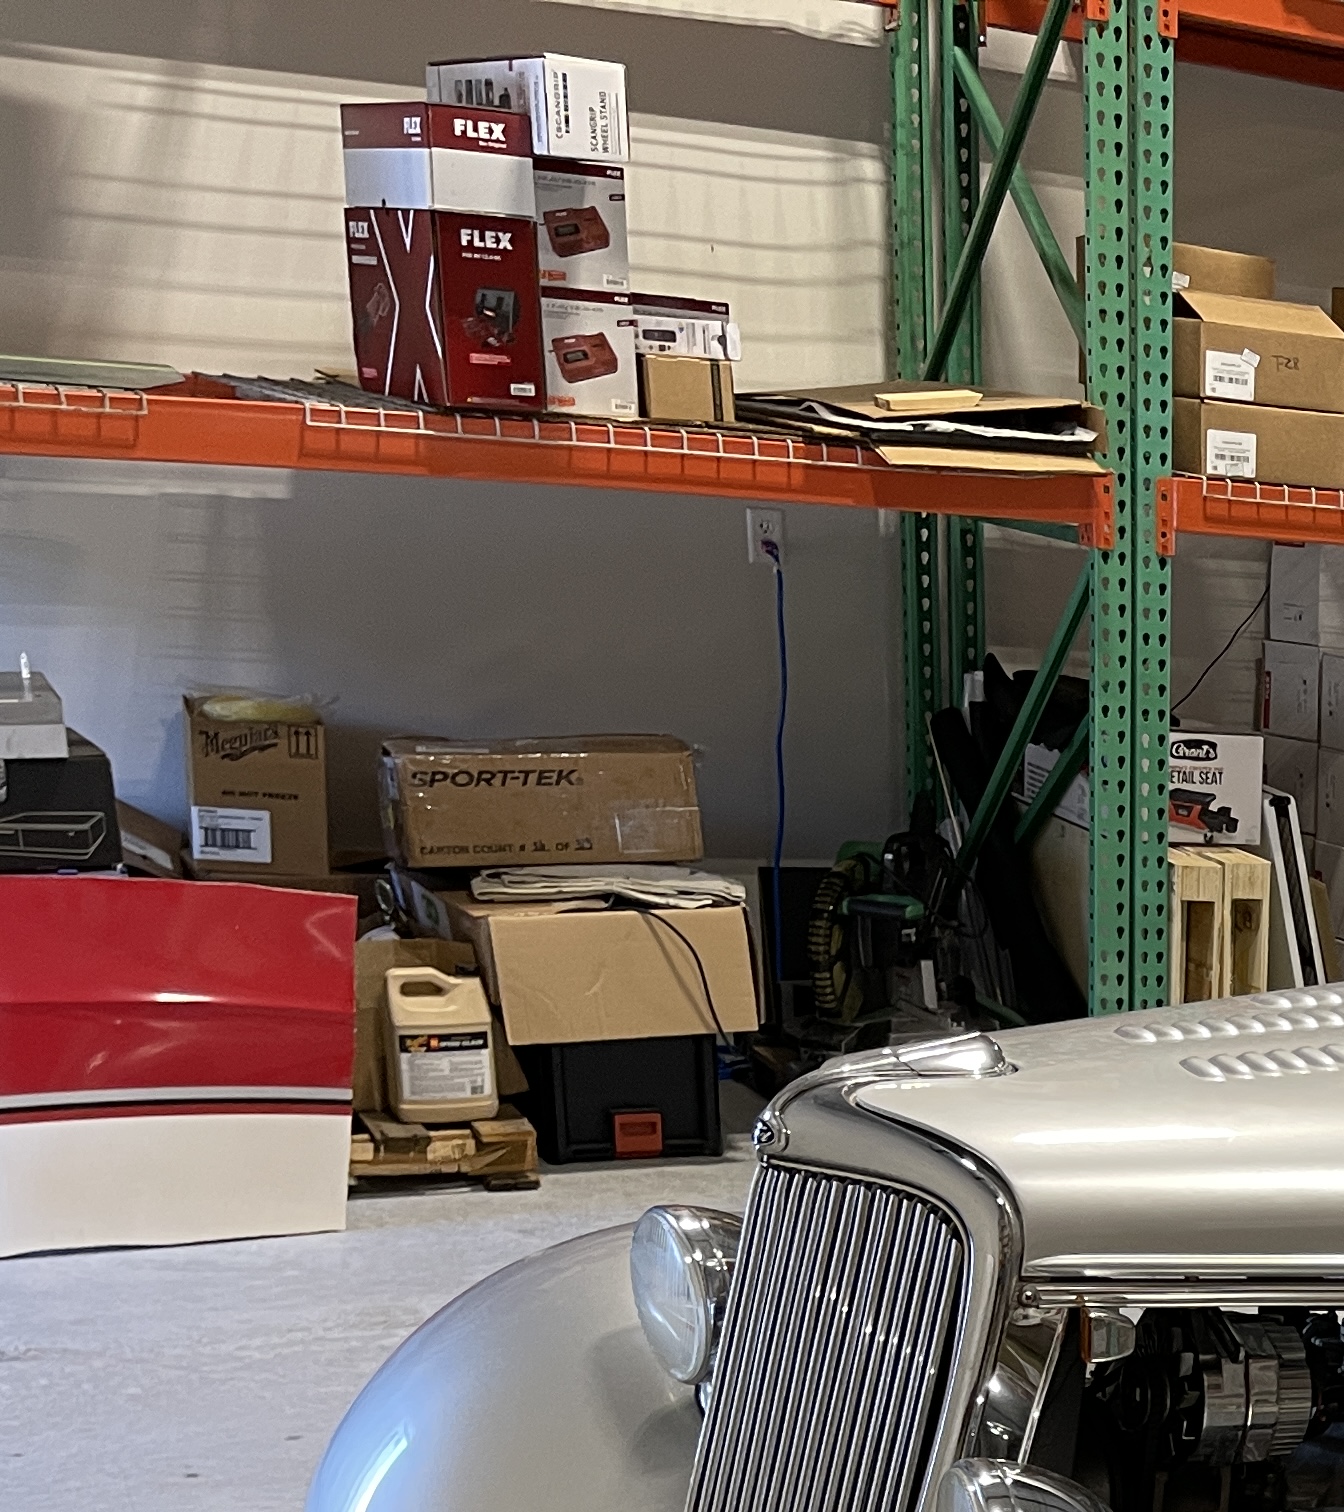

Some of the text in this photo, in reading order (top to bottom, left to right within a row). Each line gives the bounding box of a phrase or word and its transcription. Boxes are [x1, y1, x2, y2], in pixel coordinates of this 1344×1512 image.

[453, 118, 506, 142] FLEX
[589, 106, 598, 152] SCANGRIP
[599, 91, 609, 153] WHEEL STAND
[460, 228, 514, 251] FLEX
[410, 769, 578, 788] SPORT-TEK
[1170, 770, 1224, 786] ETAIL SEAT
